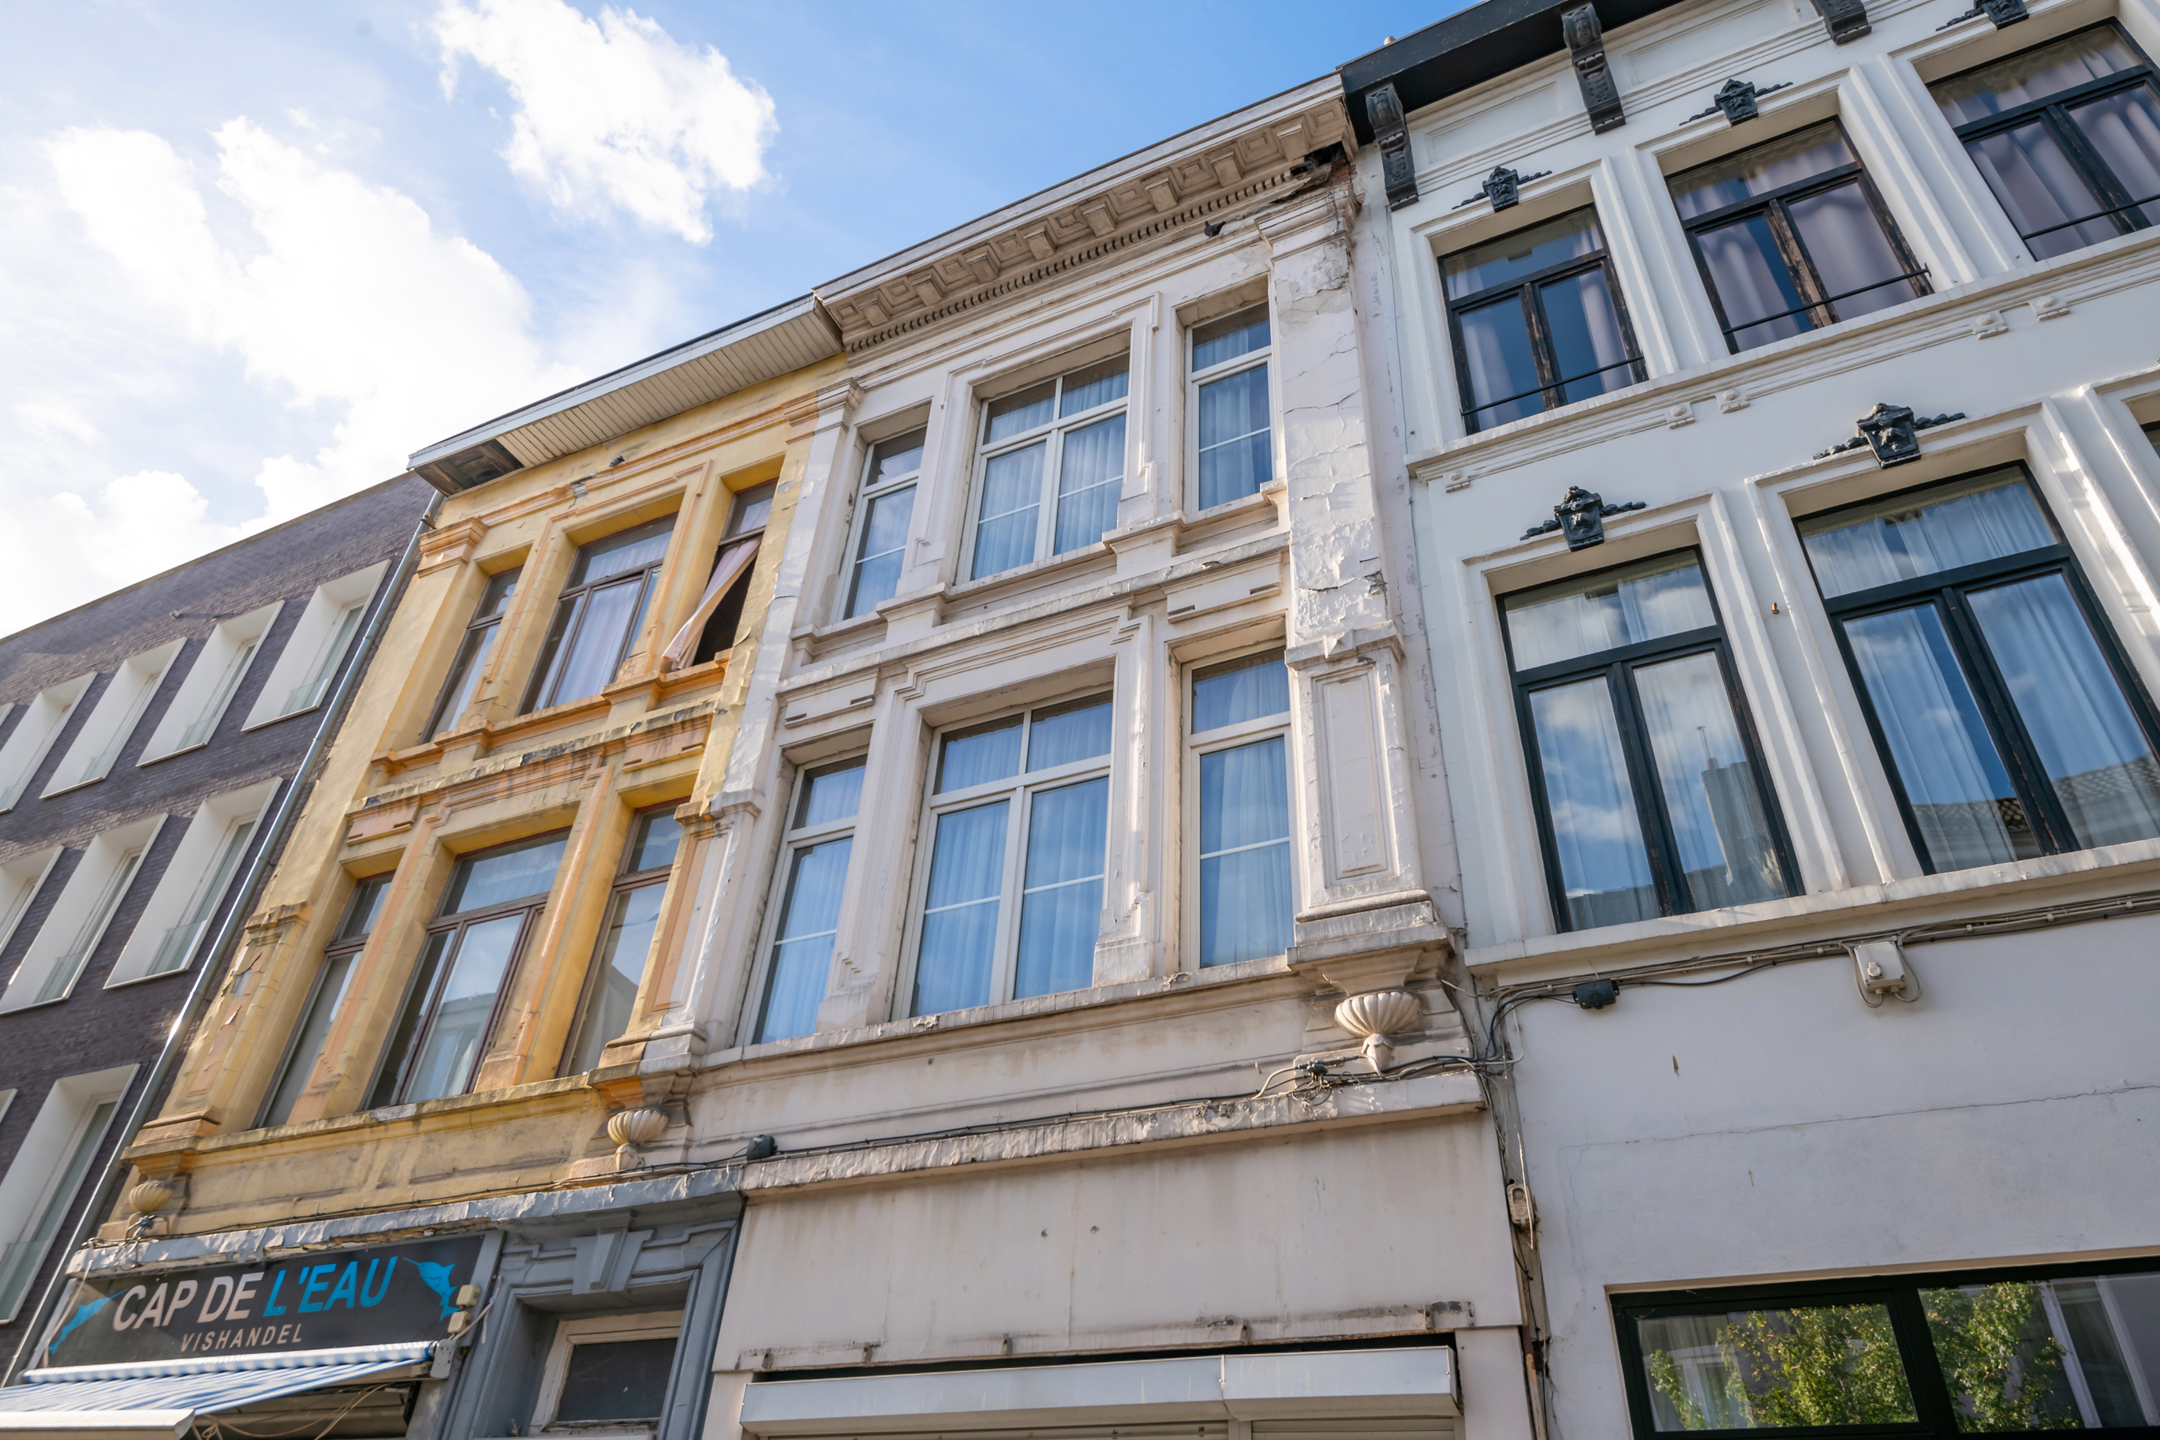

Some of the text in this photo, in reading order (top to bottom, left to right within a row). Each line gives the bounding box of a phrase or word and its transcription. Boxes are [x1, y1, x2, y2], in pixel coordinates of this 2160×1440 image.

[112, 1256, 399, 1331] CAP DE L'EAU
[180, 1323, 303, 1352] VISHANDEL
